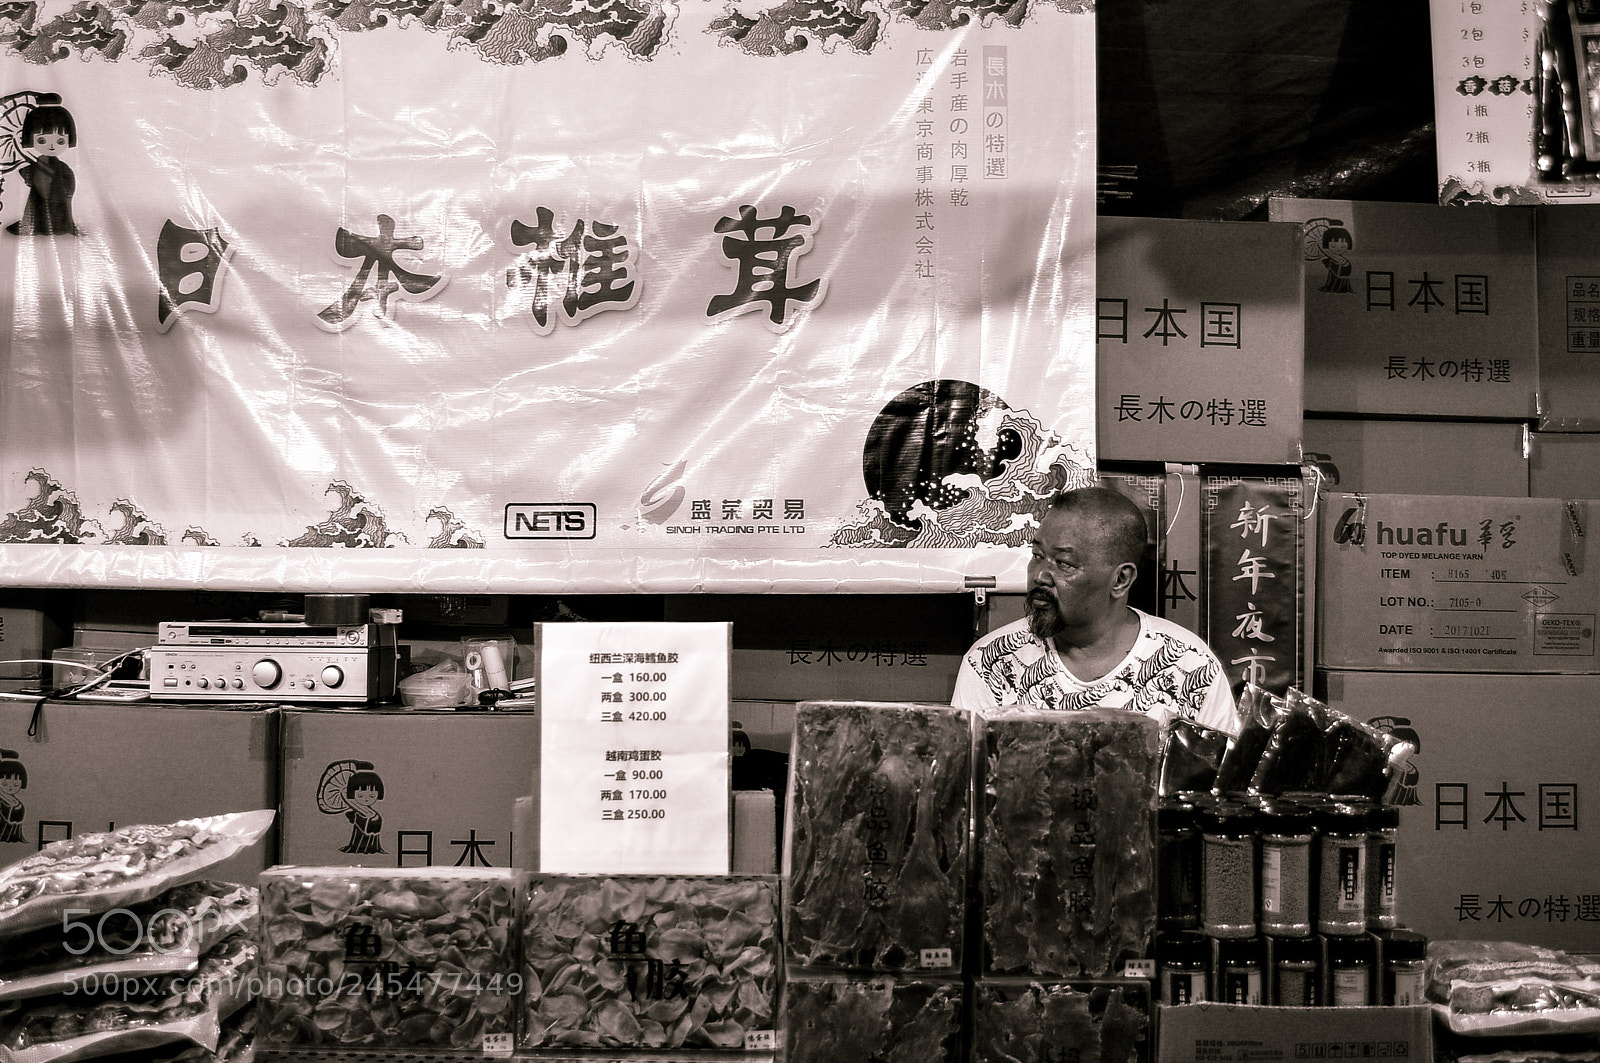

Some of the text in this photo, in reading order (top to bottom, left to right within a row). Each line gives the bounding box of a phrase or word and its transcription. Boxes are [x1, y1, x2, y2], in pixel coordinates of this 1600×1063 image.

[950, 48, 969, 207] 岩手産の肉厚乾
[1366, 270, 1489, 316] 日本国
[1573, 282, 1600, 298] 品名
[1096, 297, 1242, 350] 日本国
[1384, 356, 1511, 383] 長木の特選
[1113, 394, 1267, 427] 長木の特選
[691, 500, 804, 520] 盛荣贸易
[515, 511, 585, 531] NETS
[705, 526, 754, 534] TRADING
[757, 526, 779, 534] PTE
[783, 526, 805, 534] LTD
[1376, 521, 1467, 546] huafu
[1381, 551, 1397, 559] TOP
[1422, 552, 1460, 560] MELANGE
[1462, 552, 1483, 560] YARN
[1381, 569, 1410, 579] ITEM
[1229, 500, 1279, 685] 新年夜市
[1380, 596, 1404, 607] LOT
[1379, 625, 1412, 634] DATE
[601, 672, 667, 683] 一盒 160.00
[601, 691, 667, 703] 两盒 300.00
[601, 711, 667, 722] 三盒 420.00
[604, 770, 663, 781] 一盒 90.00
[600, 789, 667, 801] 两盒 170.00
[1435, 781, 1577, 831] 日本国
[602, 809, 665, 820] 三盒 250.00
